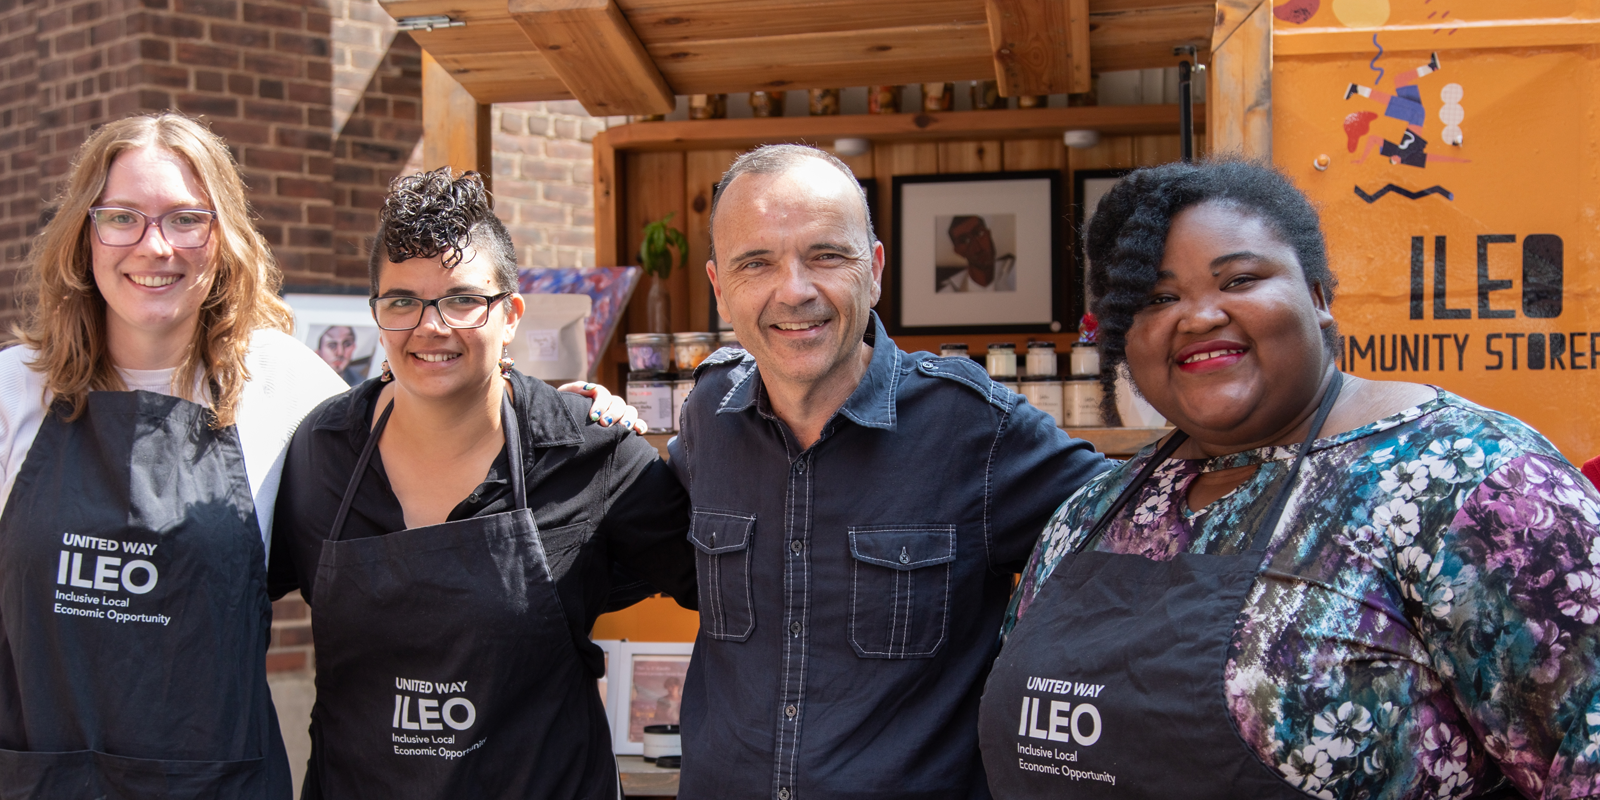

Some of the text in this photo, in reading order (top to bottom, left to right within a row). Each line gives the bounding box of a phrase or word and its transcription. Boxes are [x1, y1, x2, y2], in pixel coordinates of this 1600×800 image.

[1410, 233, 1564, 320] ILEO
[62, 532, 158, 556] UNITED WAY
[57, 550, 158, 594] ILEO
[55, 589, 130, 607] Inclusive Local
[54, 603, 171, 626] Economic Opportunity
[395, 676, 468, 694] UNITED WAY
[1026, 676, 1105, 698] UNITED WAY
[392, 694, 476, 730] ILEO
[1018, 696, 1102, 746] ILEO
[392, 732, 455, 744] Inclusive Local
[393, 745, 437, 756] Economic
[1017, 742, 1078, 762] Inclusive Local
[1018, 758, 1116, 786] Economic Opportunity
